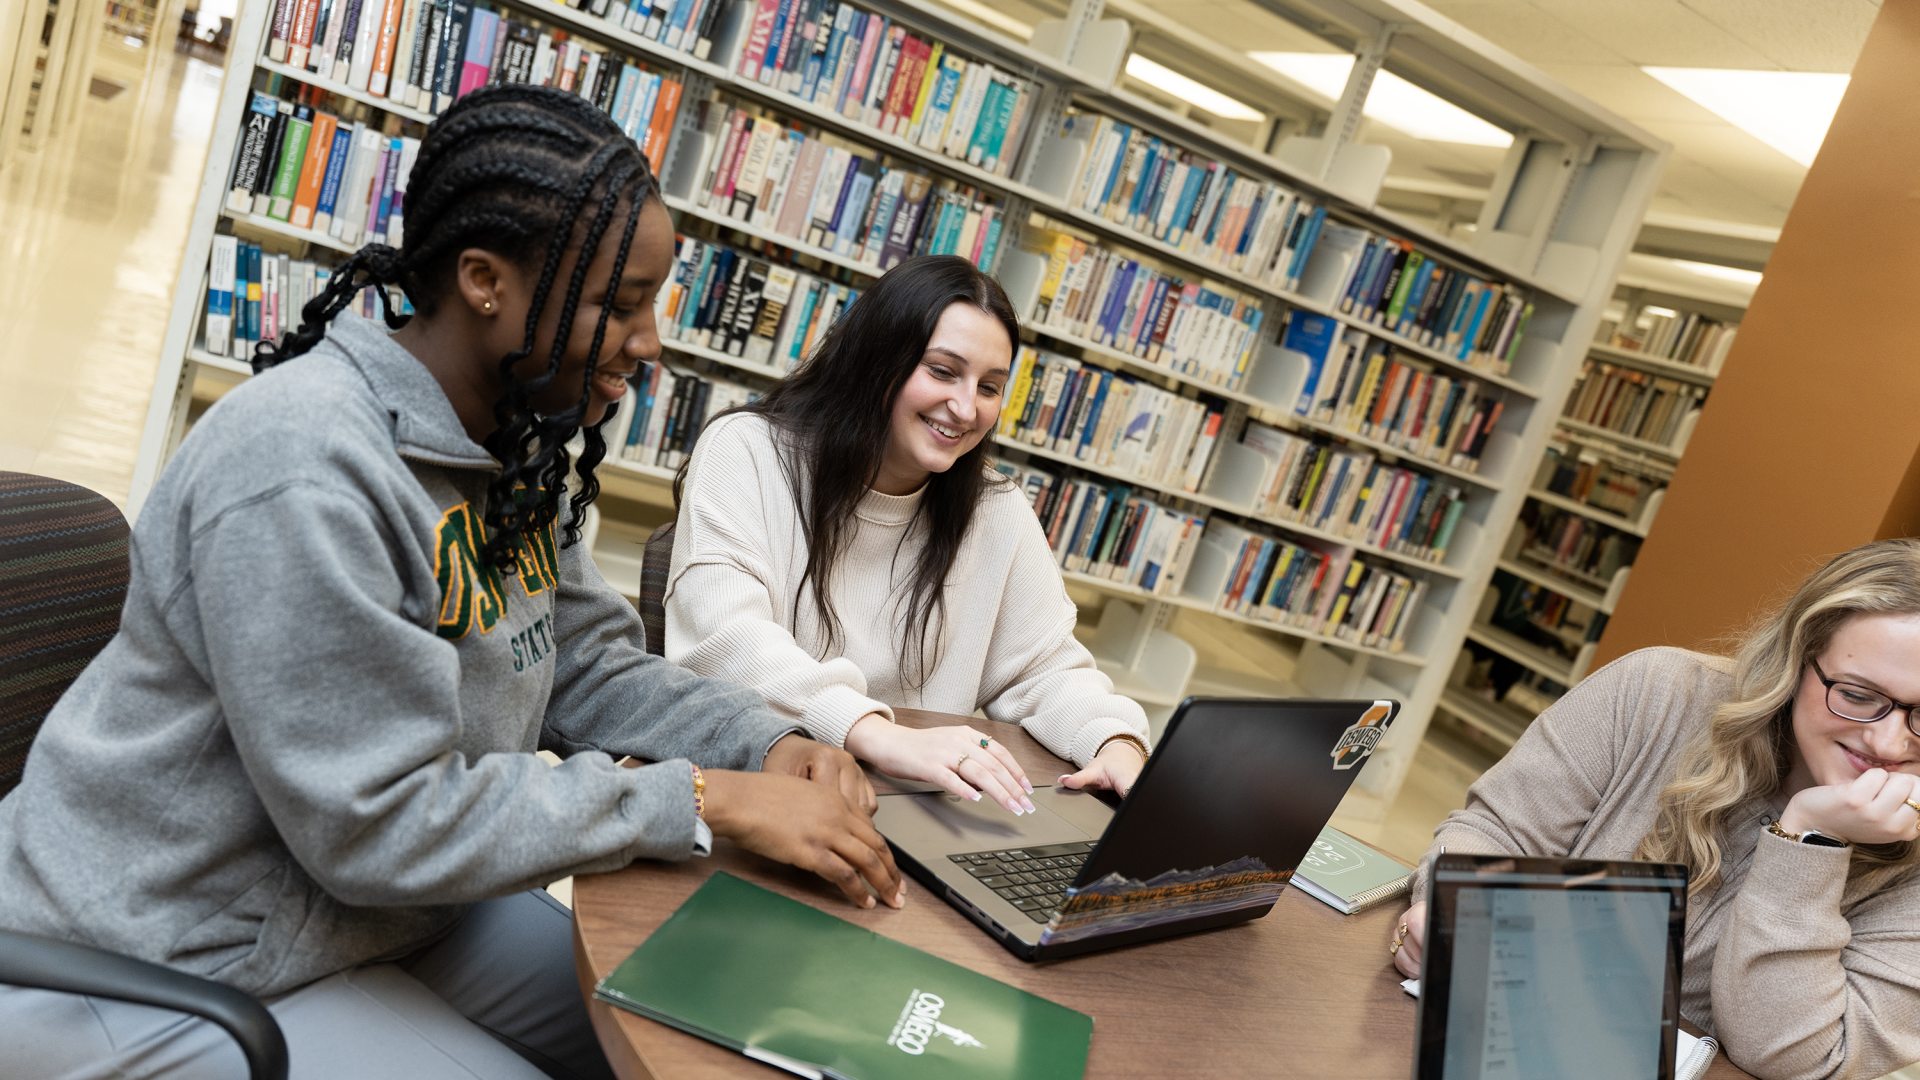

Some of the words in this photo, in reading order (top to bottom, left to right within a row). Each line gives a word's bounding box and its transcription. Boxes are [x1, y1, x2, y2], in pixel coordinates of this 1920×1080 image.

[746, 7, 775, 56] XML
[811, 12, 834, 55] XML
[936, 75, 955, 107] XML
[249, 112, 271, 131] AI
[233, 127, 256, 189] PROGRAMMING
[251, 131, 266, 157] GAME
[719, 283, 741, 324] HTML
[731, 286, 761, 337] XML
[757, 300, 783, 339] HTML
[1152, 288, 1180, 336] Linux
[1335, 728, 1381, 752] OSWEGO
[896, 992, 945, 1055] OSWEGO
